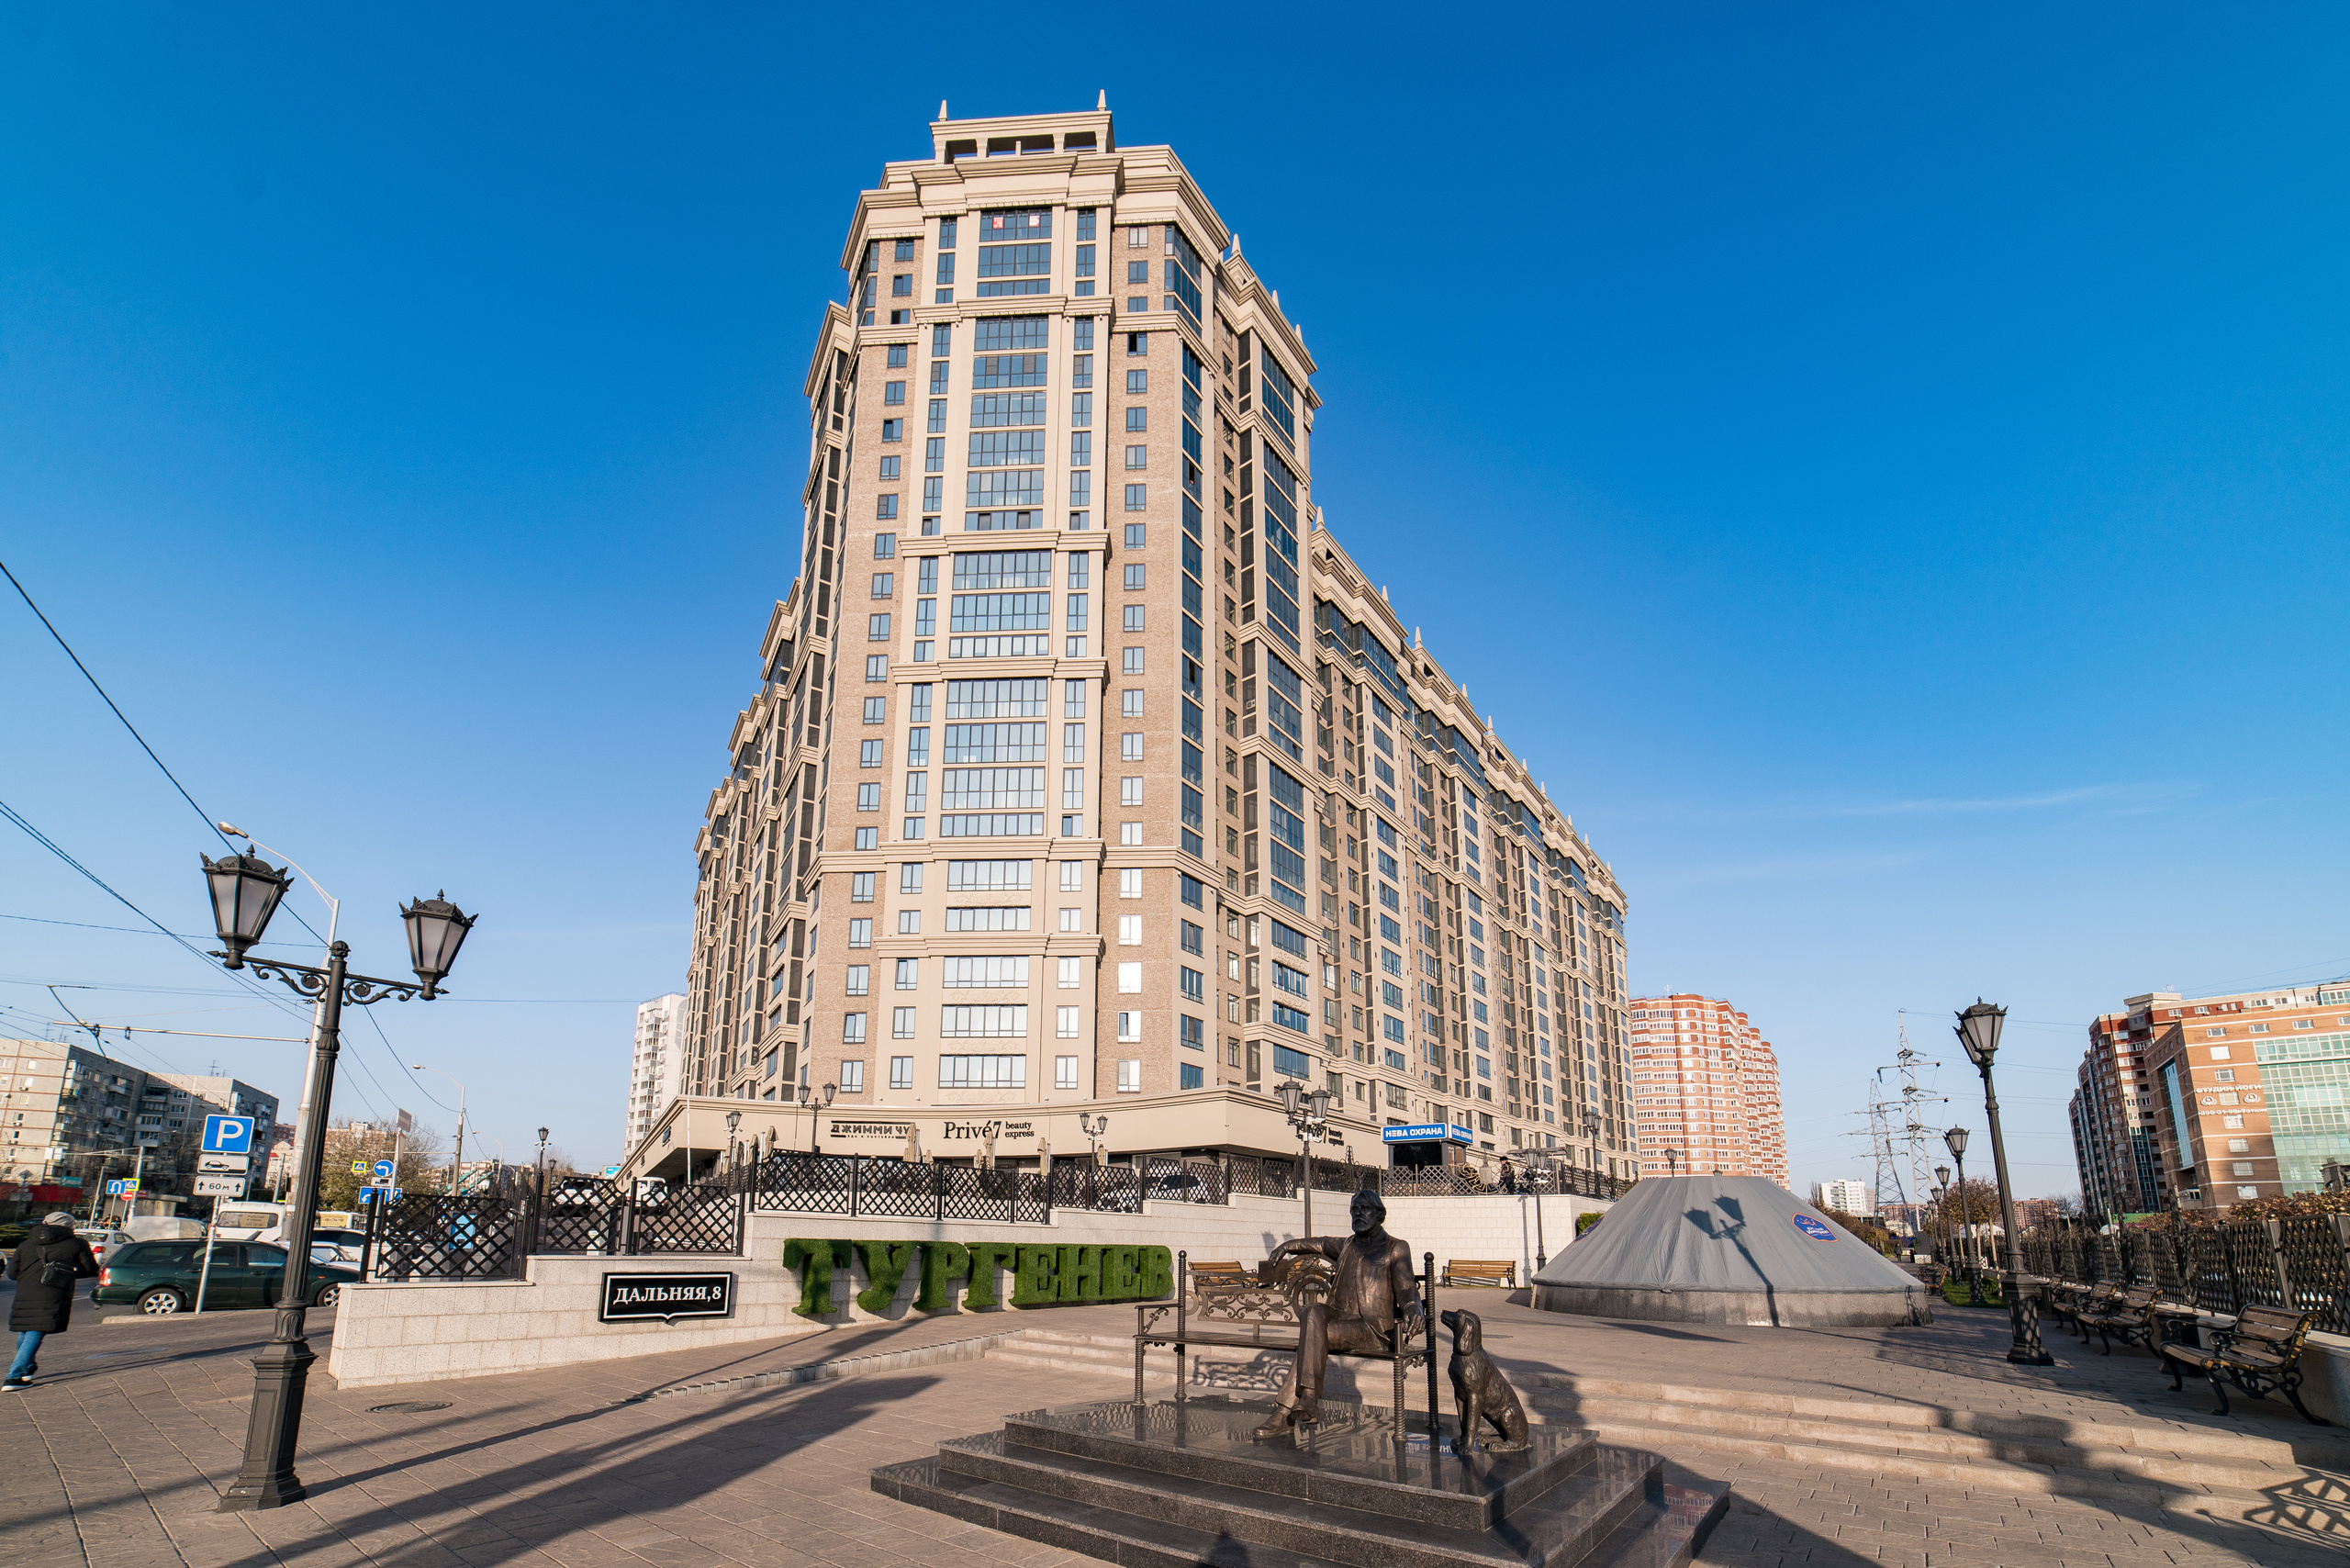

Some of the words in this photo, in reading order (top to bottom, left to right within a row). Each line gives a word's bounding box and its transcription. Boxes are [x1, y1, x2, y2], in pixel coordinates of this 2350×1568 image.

[830, 1124, 893, 1135] ДЖИММИ
[1005, 1121, 1033, 1130] beauty
[215, 1119, 244, 1148] P
[1004, 1130, 1035, 1140] express
[1385, 1129, 1408, 1137] НЕВА
[1409, 1126, 1443, 1137] ОХРАНА
[783, 1238, 1174, 1315] ТУРГЕНЕВ
